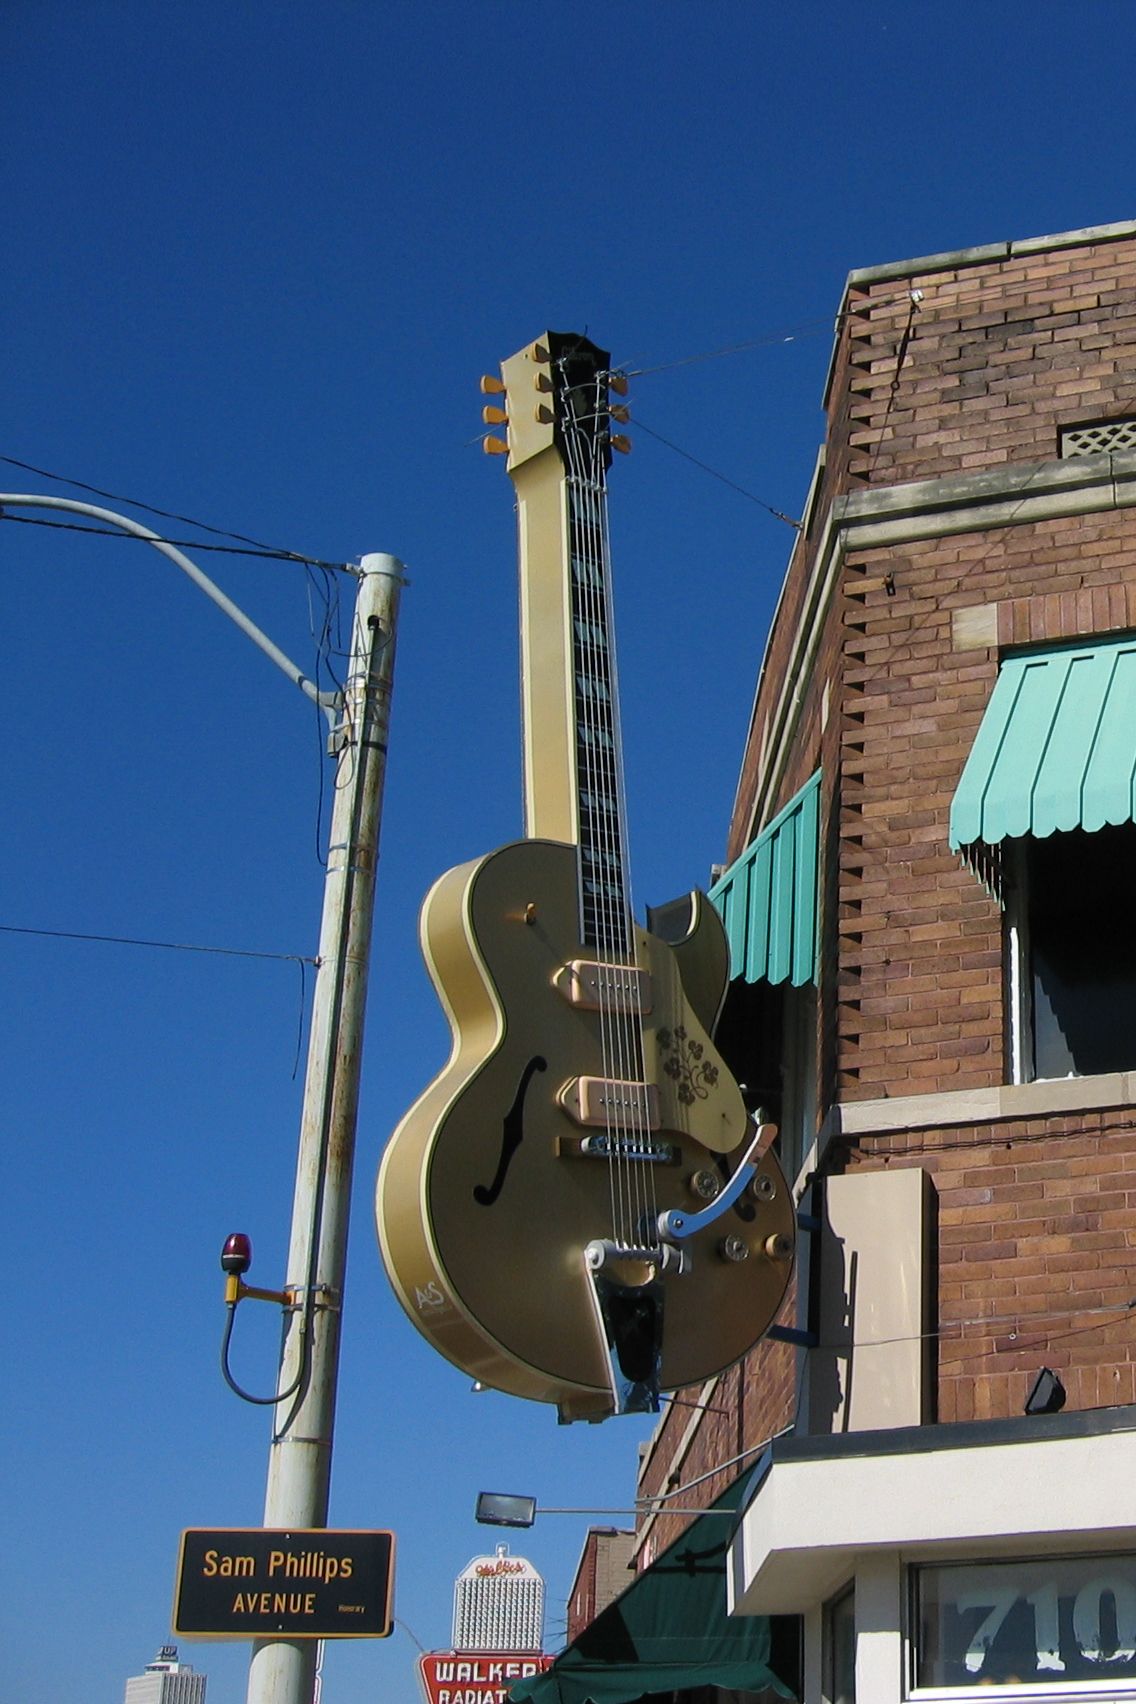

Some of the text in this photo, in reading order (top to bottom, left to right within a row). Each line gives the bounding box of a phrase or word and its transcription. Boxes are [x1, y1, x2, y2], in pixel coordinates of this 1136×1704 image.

[203, 1550, 353, 1584] Sam Phillips
[232, 1592, 316, 1614] AVENUE
[436, 1661, 538, 1682] WALKER
[438, 1689, 508, 1704] RADIAT
